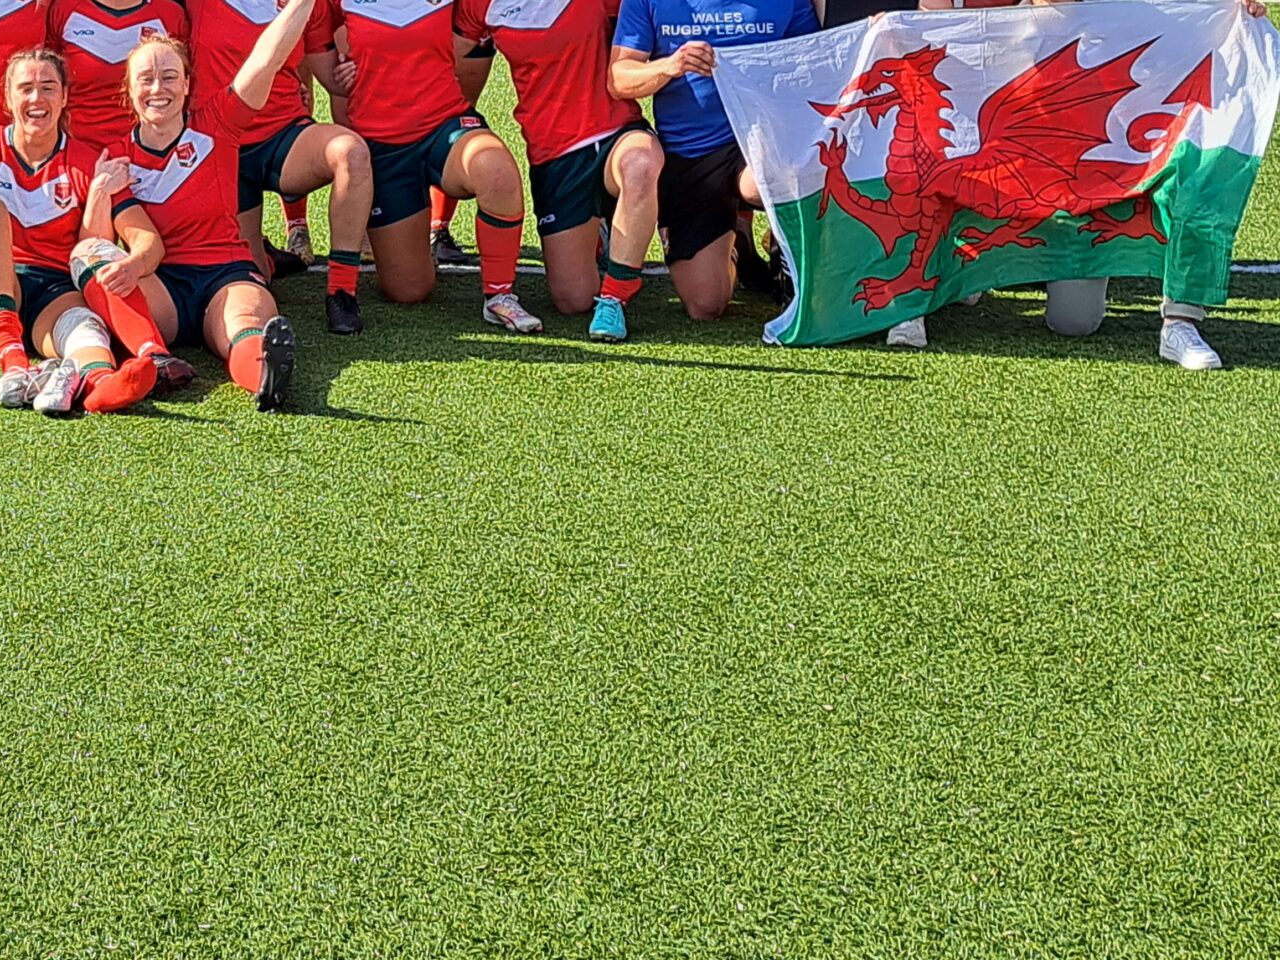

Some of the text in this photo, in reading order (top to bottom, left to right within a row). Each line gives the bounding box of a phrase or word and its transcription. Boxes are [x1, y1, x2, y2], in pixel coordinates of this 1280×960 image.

[691, 12, 743, 24] WALES
[661, 22, 775, 36] RUGBY LEAGUE
